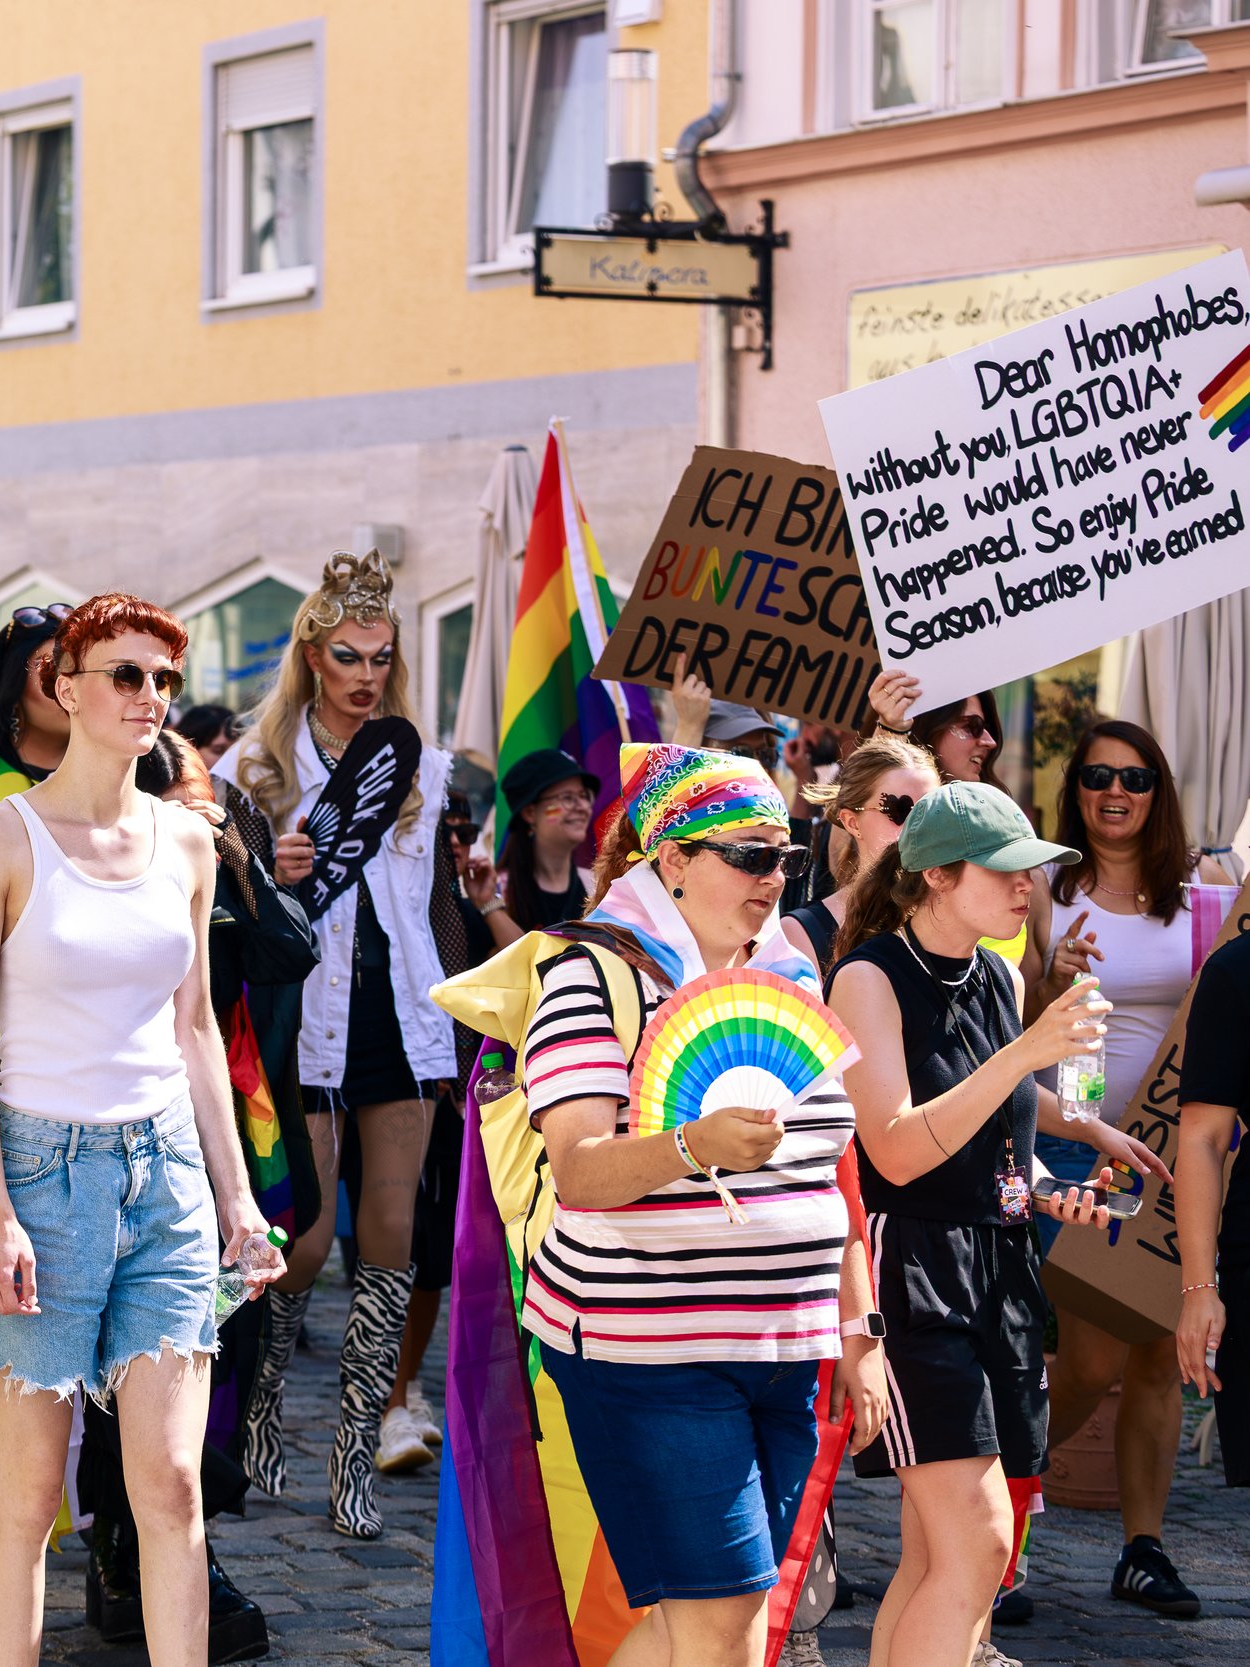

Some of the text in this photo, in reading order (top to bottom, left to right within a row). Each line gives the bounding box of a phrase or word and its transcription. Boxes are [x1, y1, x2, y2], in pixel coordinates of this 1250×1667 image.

[975, 284, 1250, 410] Dear Homophobes,
[847, 365, 1182, 499] without you, LGBTQIA+
[861, 411, 1192, 557] Pride would have never
[688, 467, 856, 559] ICH BIN
[873, 457, 1214, 607] happened. So enjoy Pride
[885, 490, 1246, 659] Season, because you've earned
[622, 616, 730, 690] DER
[313, 743, 397, 907] FUCK OFF
[1004, 1187, 1023, 1196] CREW
